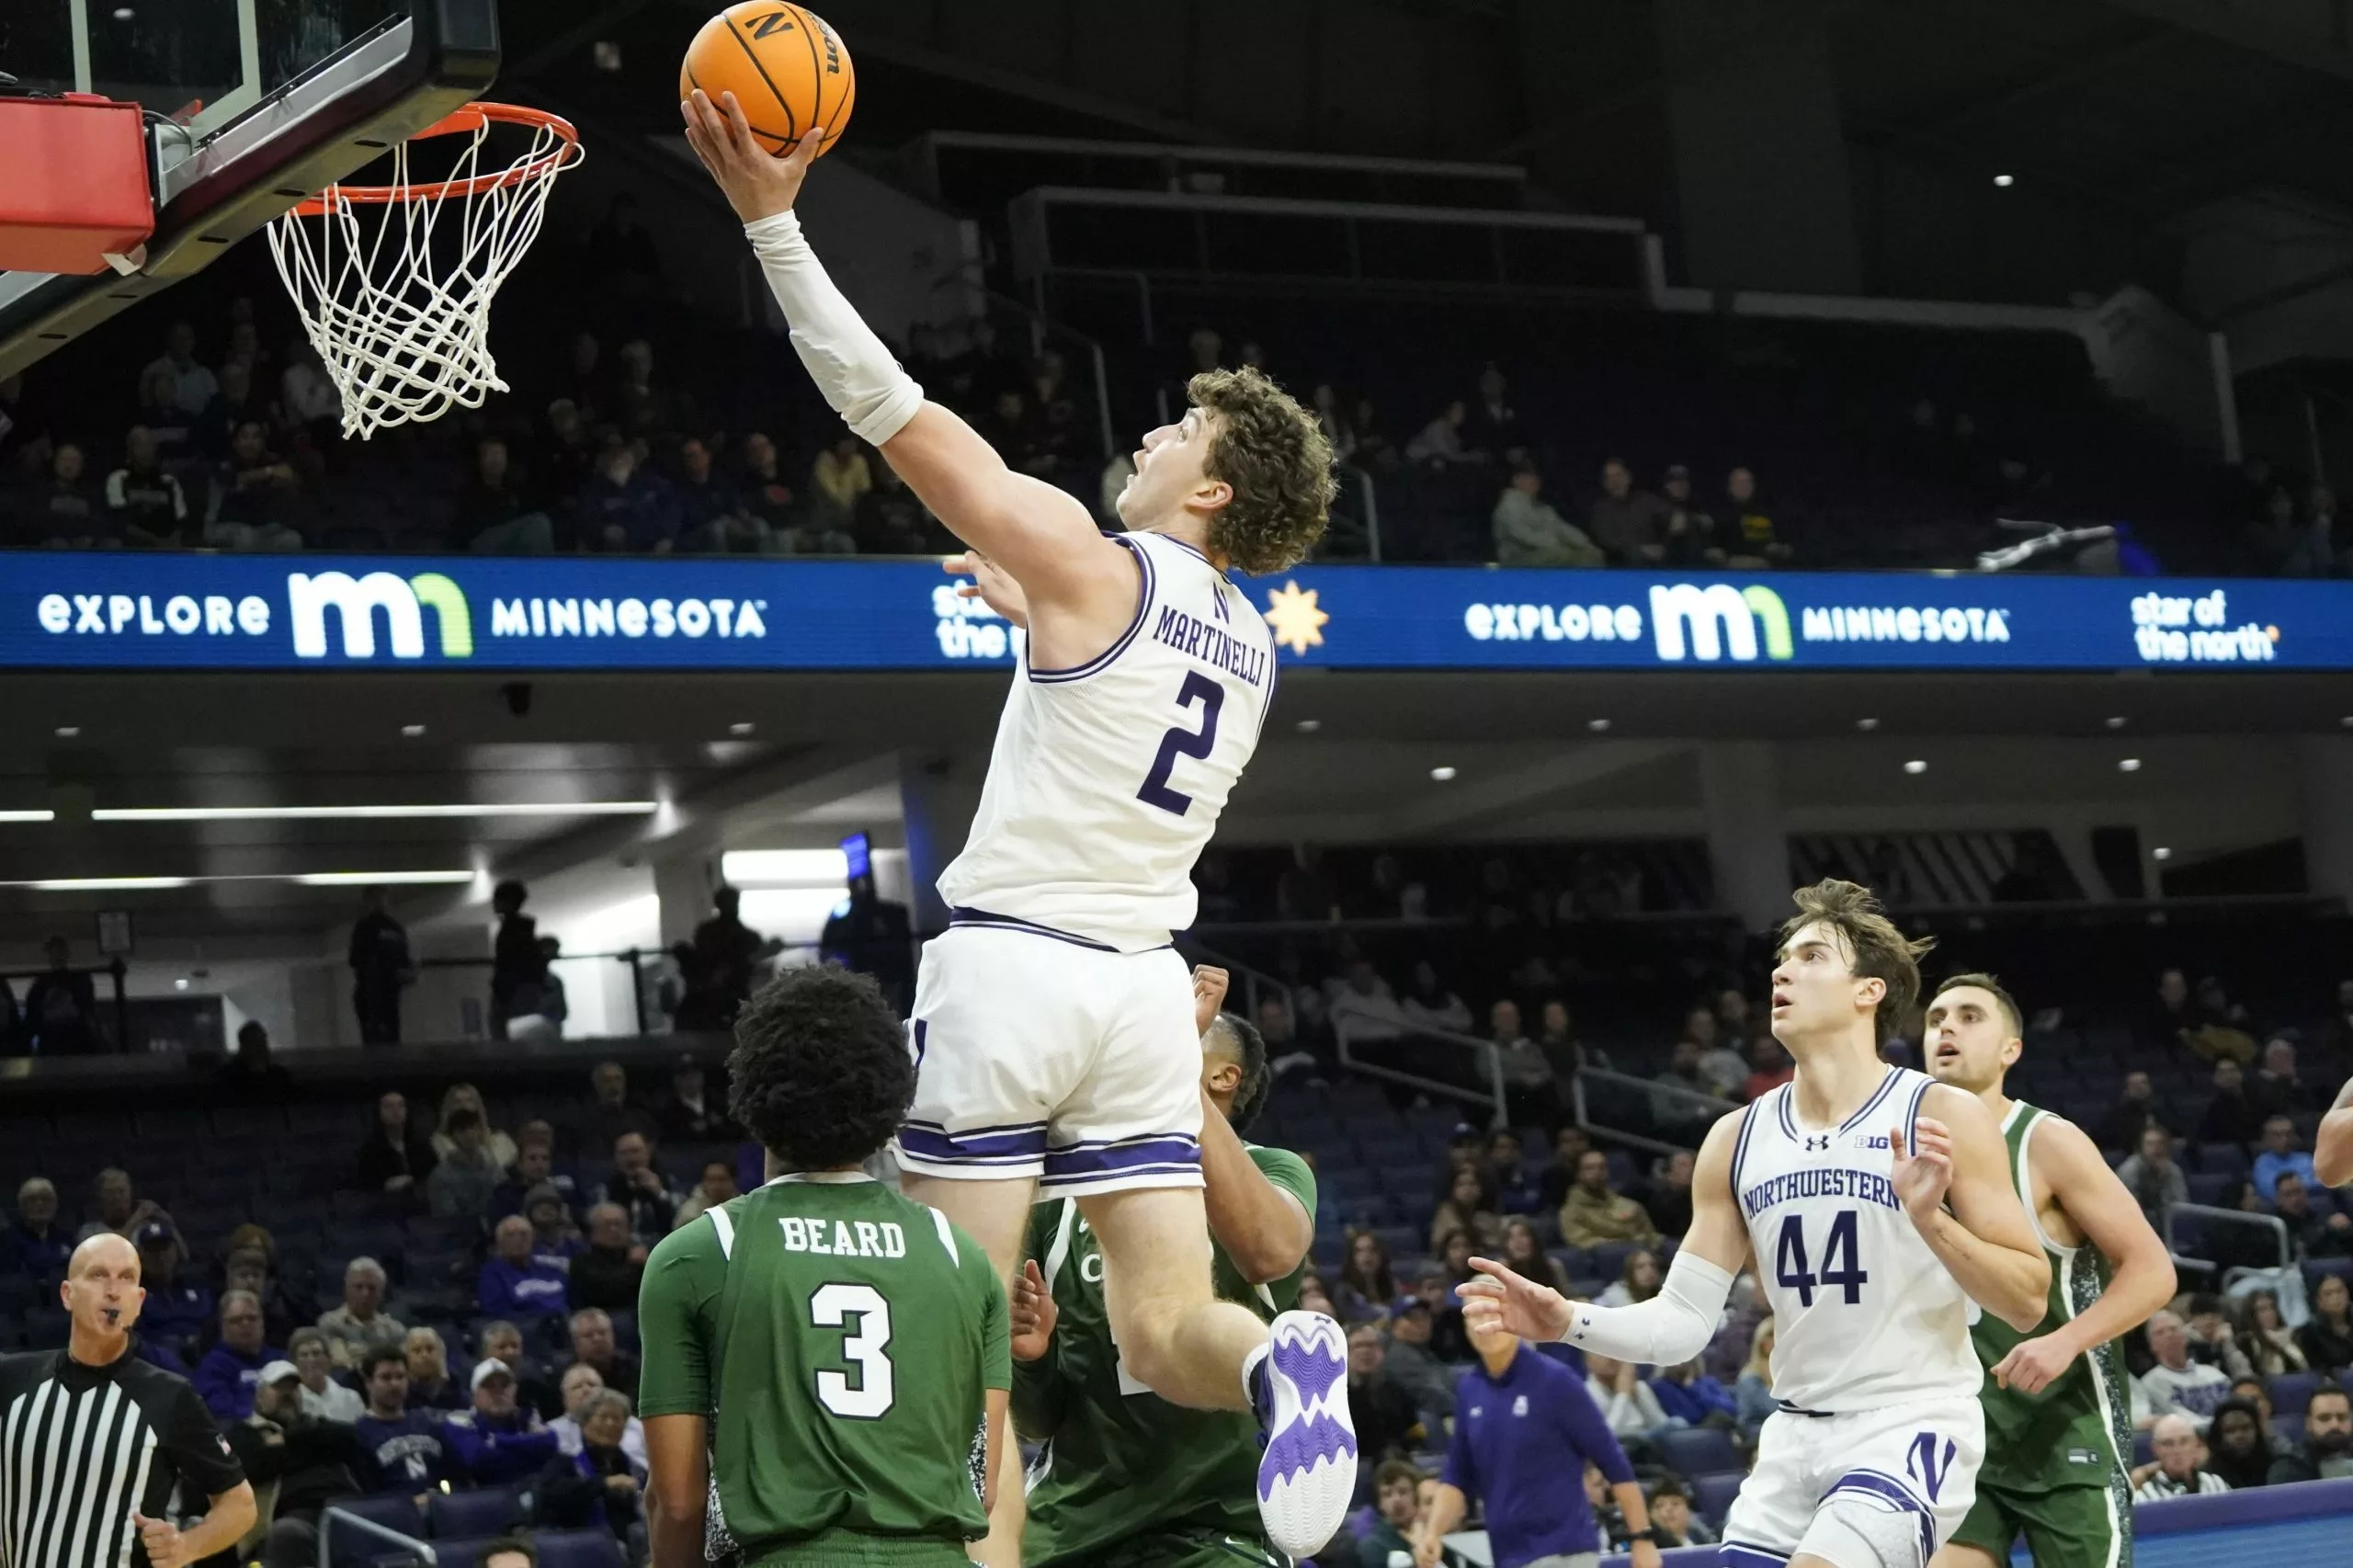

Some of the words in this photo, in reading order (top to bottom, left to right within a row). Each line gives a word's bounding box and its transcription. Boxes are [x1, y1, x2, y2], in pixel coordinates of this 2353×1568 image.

[289, 572, 472, 657] mn
[937, 615, 1006, 658] the
[1153, 605, 1266, 687] MARTINELLI
[1650, 584, 1793, 661] mn
[2131, 592, 2192, 625] star
[2194, 589, 2226, 626] of
[2134, 624, 2189, 661] the
[1136, 669, 1225, 817] 2
[1744, 1168, 1900, 1220] NORTHWESTERN
[779, 1217, 906, 1258] BEARD
[1777, 1210, 1868, 1307] 44
[808, 1280, 896, 1422] 3
